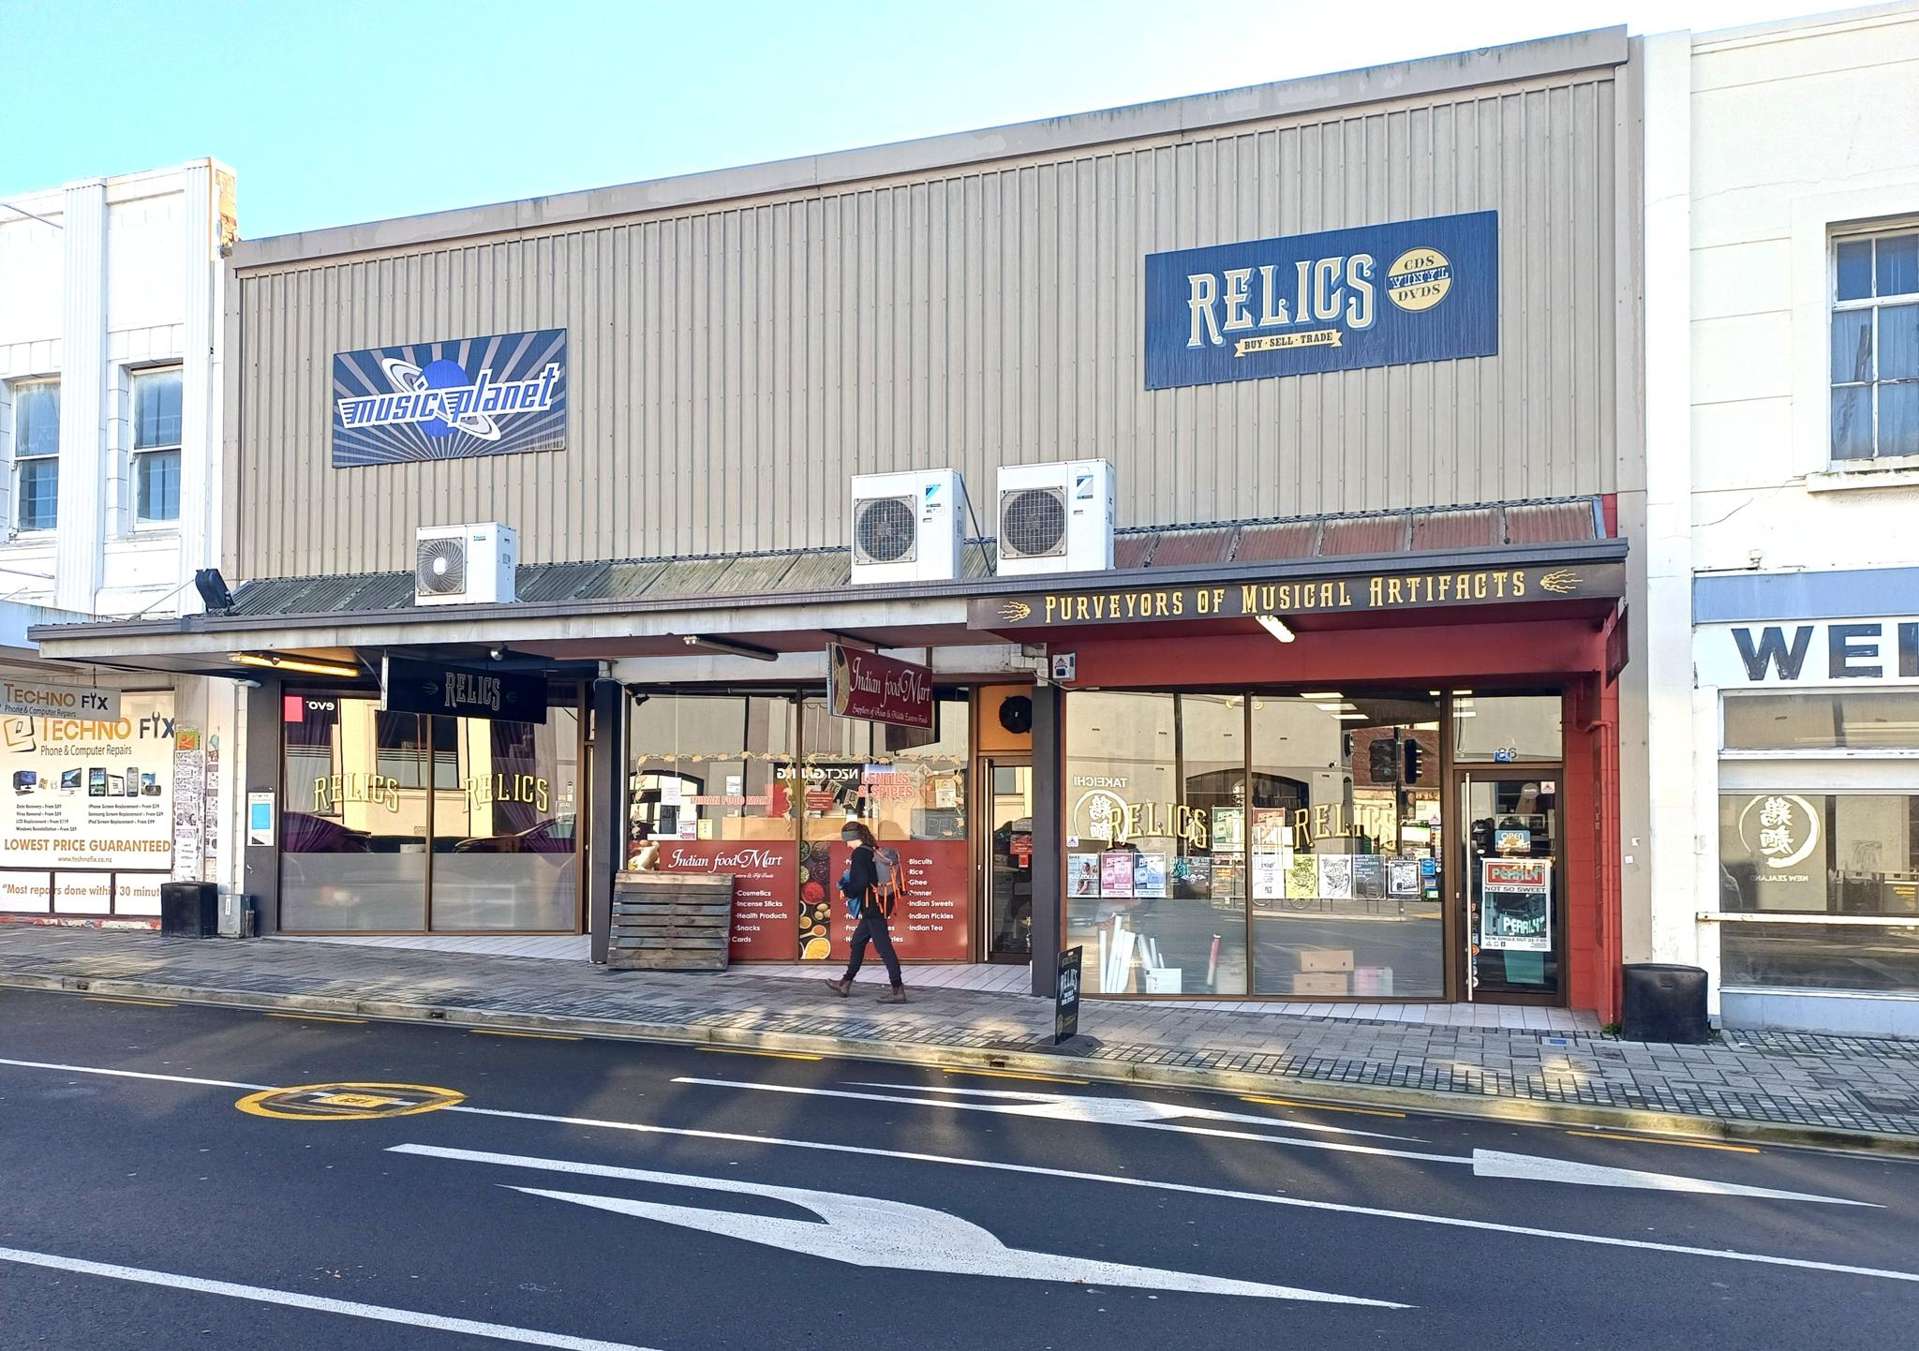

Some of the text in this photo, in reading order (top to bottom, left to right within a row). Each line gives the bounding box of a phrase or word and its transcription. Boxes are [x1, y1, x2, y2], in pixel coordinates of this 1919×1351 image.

[1404, 255, 1435, 271] CDS
[1389, 267, 1450, 289] VINYL
[1186, 254, 1377, 348] RELICS
[1397, 284, 1442, 303] DVDS
[1244, 332, 1334, 351] BUY SELL TRADE
[340, 363, 560, 427] music planet
[1045, 570, 1525, 622] PURVEYORS OF MUSICAL ARTIFACTS
[444, 672, 501, 711] RELICS
[850, 657, 930, 707] Indian food Mart
[4, 683, 109, 710] TECHNO FIX
[41, 744, 132, 758] Phone & Computer Repairs
[313, 773, 400, 814] RELICS
[462, 773, 549, 814] RELICS
[1108, 801, 1208, 850] RELICS
[4, 840, 171, 853] LOWEST PRICE GUARANTEED
[668, 849, 783, 873] Indian food Mart
[64, 884, 87, 895] done
[120, 886, 131, 896] 30
[133, 886, 161, 897] minut
